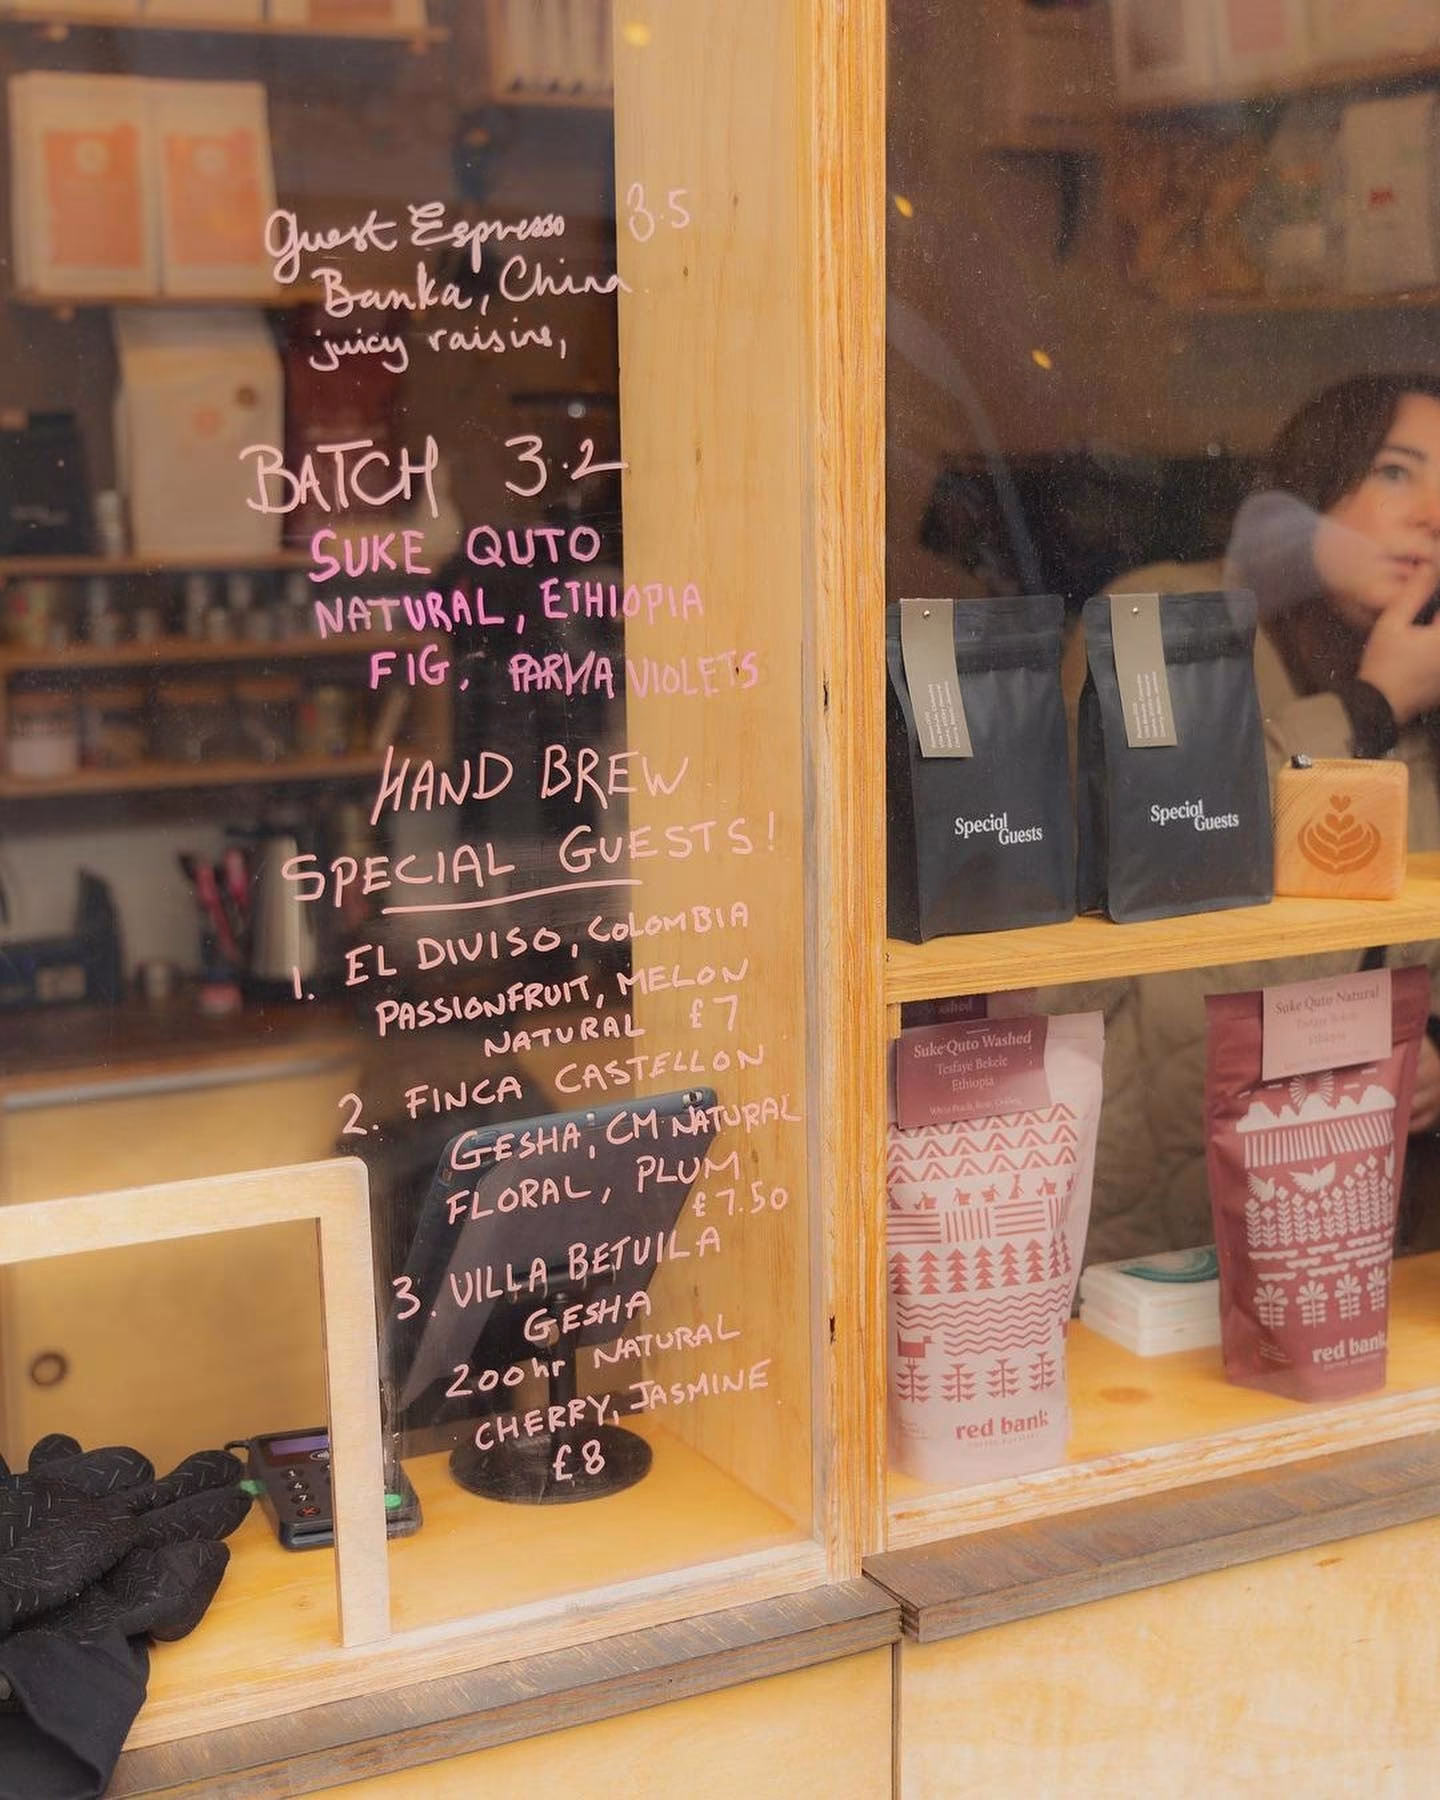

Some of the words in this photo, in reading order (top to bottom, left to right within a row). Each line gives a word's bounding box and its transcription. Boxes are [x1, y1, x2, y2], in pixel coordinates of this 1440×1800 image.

[408, 202, 565, 273] Espresso
[626, 182, 690, 242] 3.5
[311, 262, 488, 318] Banka,
[309, 328, 409, 374] juicy
[239, 435, 439, 518] BATCH
[504, 435, 629, 497] 3.2
[308, 528, 432, 582] SUKE
[467, 525, 601, 568] QUTO
[314, 586, 525, 640] NATURAL,
[540, 576, 704, 625] ETHIOPIA
[369, 643, 471, 692] FIG,
[626, 649, 760, 699] VIOLETS
[370, 745, 515, 827] HAND
[540, 744, 689, 810] BREW
[1149, 799, 1204, 825] Special
[954, 812, 1009, 839] Special
[998, 825, 1043, 846] Guests
[1194, 810, 1240, 832] Guests
[281, 842, 516, 908] SPECIAL
[558, 811, 777, 874] GUESTS!
[344, 943, 397, 987] EL
[416, 925, 579, 971] DIVISO,
[376, 974, 606, 1037] PASSIONFRUIT,
[616, 957, 749, 997] MELON
[1274, 998, 1302, 1015] Suke
[1302, 995, 1333, 1012] Quto
[1337, 984, 1380, 1002] Natural
[483, 1013, 646, 1058] NATURAL
[913, 1040, 945, 1059] Suke
[946, 1037, 980, 1057] Quto
[982, 1029, 1032, 1048] Washed
[404, 1075, 523, 1120] FINCA
[554, 1044, 766, 1094] CASTELLON
[951, 1076, 995, 1092] Ethiopia
[450, 1122, 597, 1173] GESHA,
[606, 1110, 659, 1146] CM
[671, 1094, 803, 1138] NATURAL
[446, 1175, 613, 1225] FLORAL,
[635, 1150, 742, 1194] PLUM
[692, 1186, 789, 1218] £7.50
[523, 1290, 653, 1343] GESHA
[445, 1357, 567, 1399] 200hr
[593, 1314, 742, 1369] NATURAL
[1312, 1339, 1346, 1363] red
[475, 1393, 620, 1451] CHERRY,
[629, 1358, 772, 1412] JASMINE
[954, 1417, 994, 1440] red
[1000, 1408, 1049, 1435] bank
[552, 1439, 606, 1482] £8
